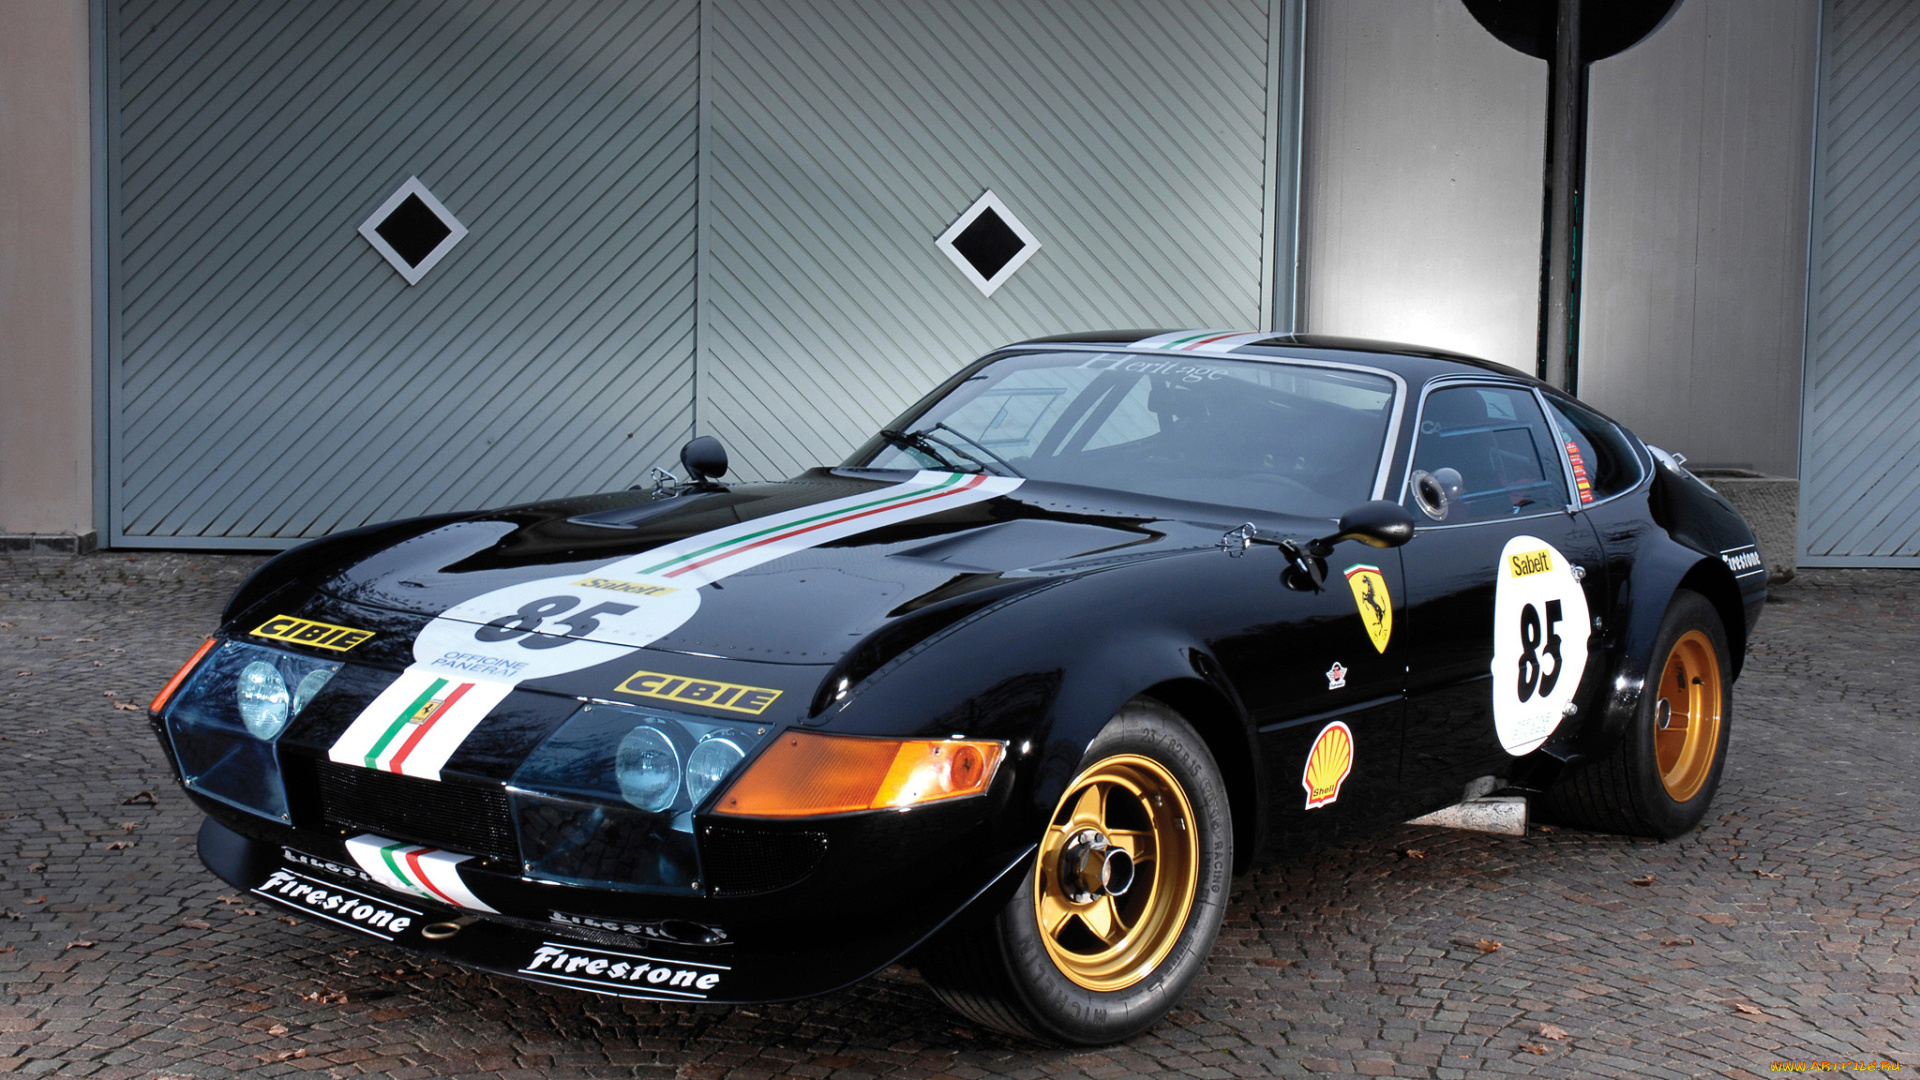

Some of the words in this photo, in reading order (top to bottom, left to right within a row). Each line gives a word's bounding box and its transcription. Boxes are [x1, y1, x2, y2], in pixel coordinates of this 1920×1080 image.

[1076, 353, 1229, 382] Heritage
[1513, 552, 1549, 577] Sabelt
[581, 578, 665, 595] Sabelt
[475, 595, 640, 650] 85
[443, 651, 529, 671] OFFICINE
[1517, 599, 1563, 703] 85
[431, 658, 518, 678] PANERAI
[1313, 785, 1335, 797] Shell
[1211, 841, 1224, 893] RACING
[260, 871, 411, 933] Firestone
[527, 946, 720, 990] Firestone
